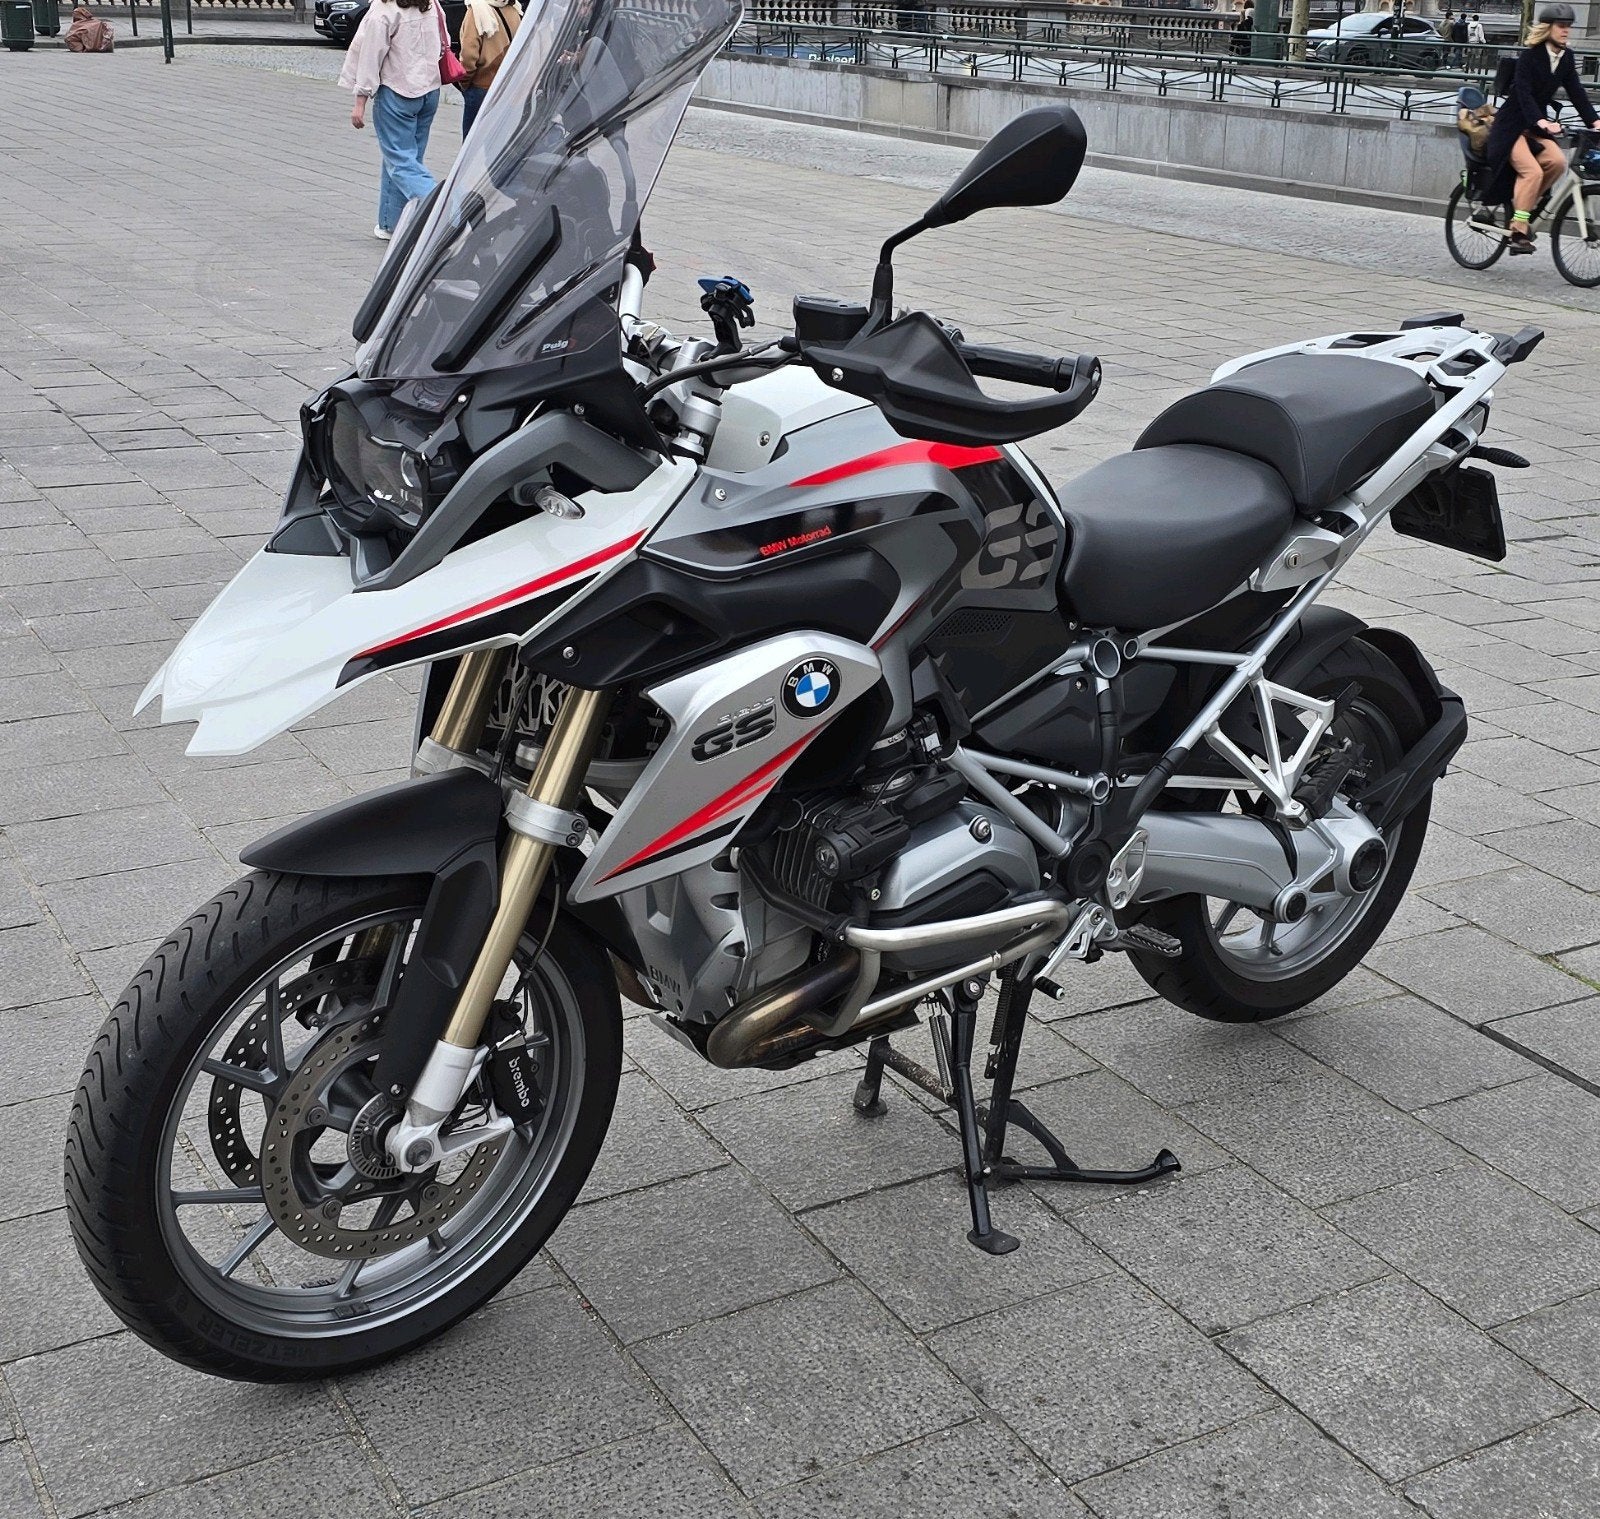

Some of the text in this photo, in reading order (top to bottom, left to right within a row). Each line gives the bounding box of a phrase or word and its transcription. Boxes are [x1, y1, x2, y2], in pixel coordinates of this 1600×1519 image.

[541, 339, 569, 353] Puig
[759, 524, 832, 556] BMW Motorrad
[961, 499, 1058, 590] GS
[787, 662, 834, 688] BMW
[691, 705, 776, 763] GS
[649, 964, 681, 997] BMW
[508, 1056, 530, 1108] brembo
